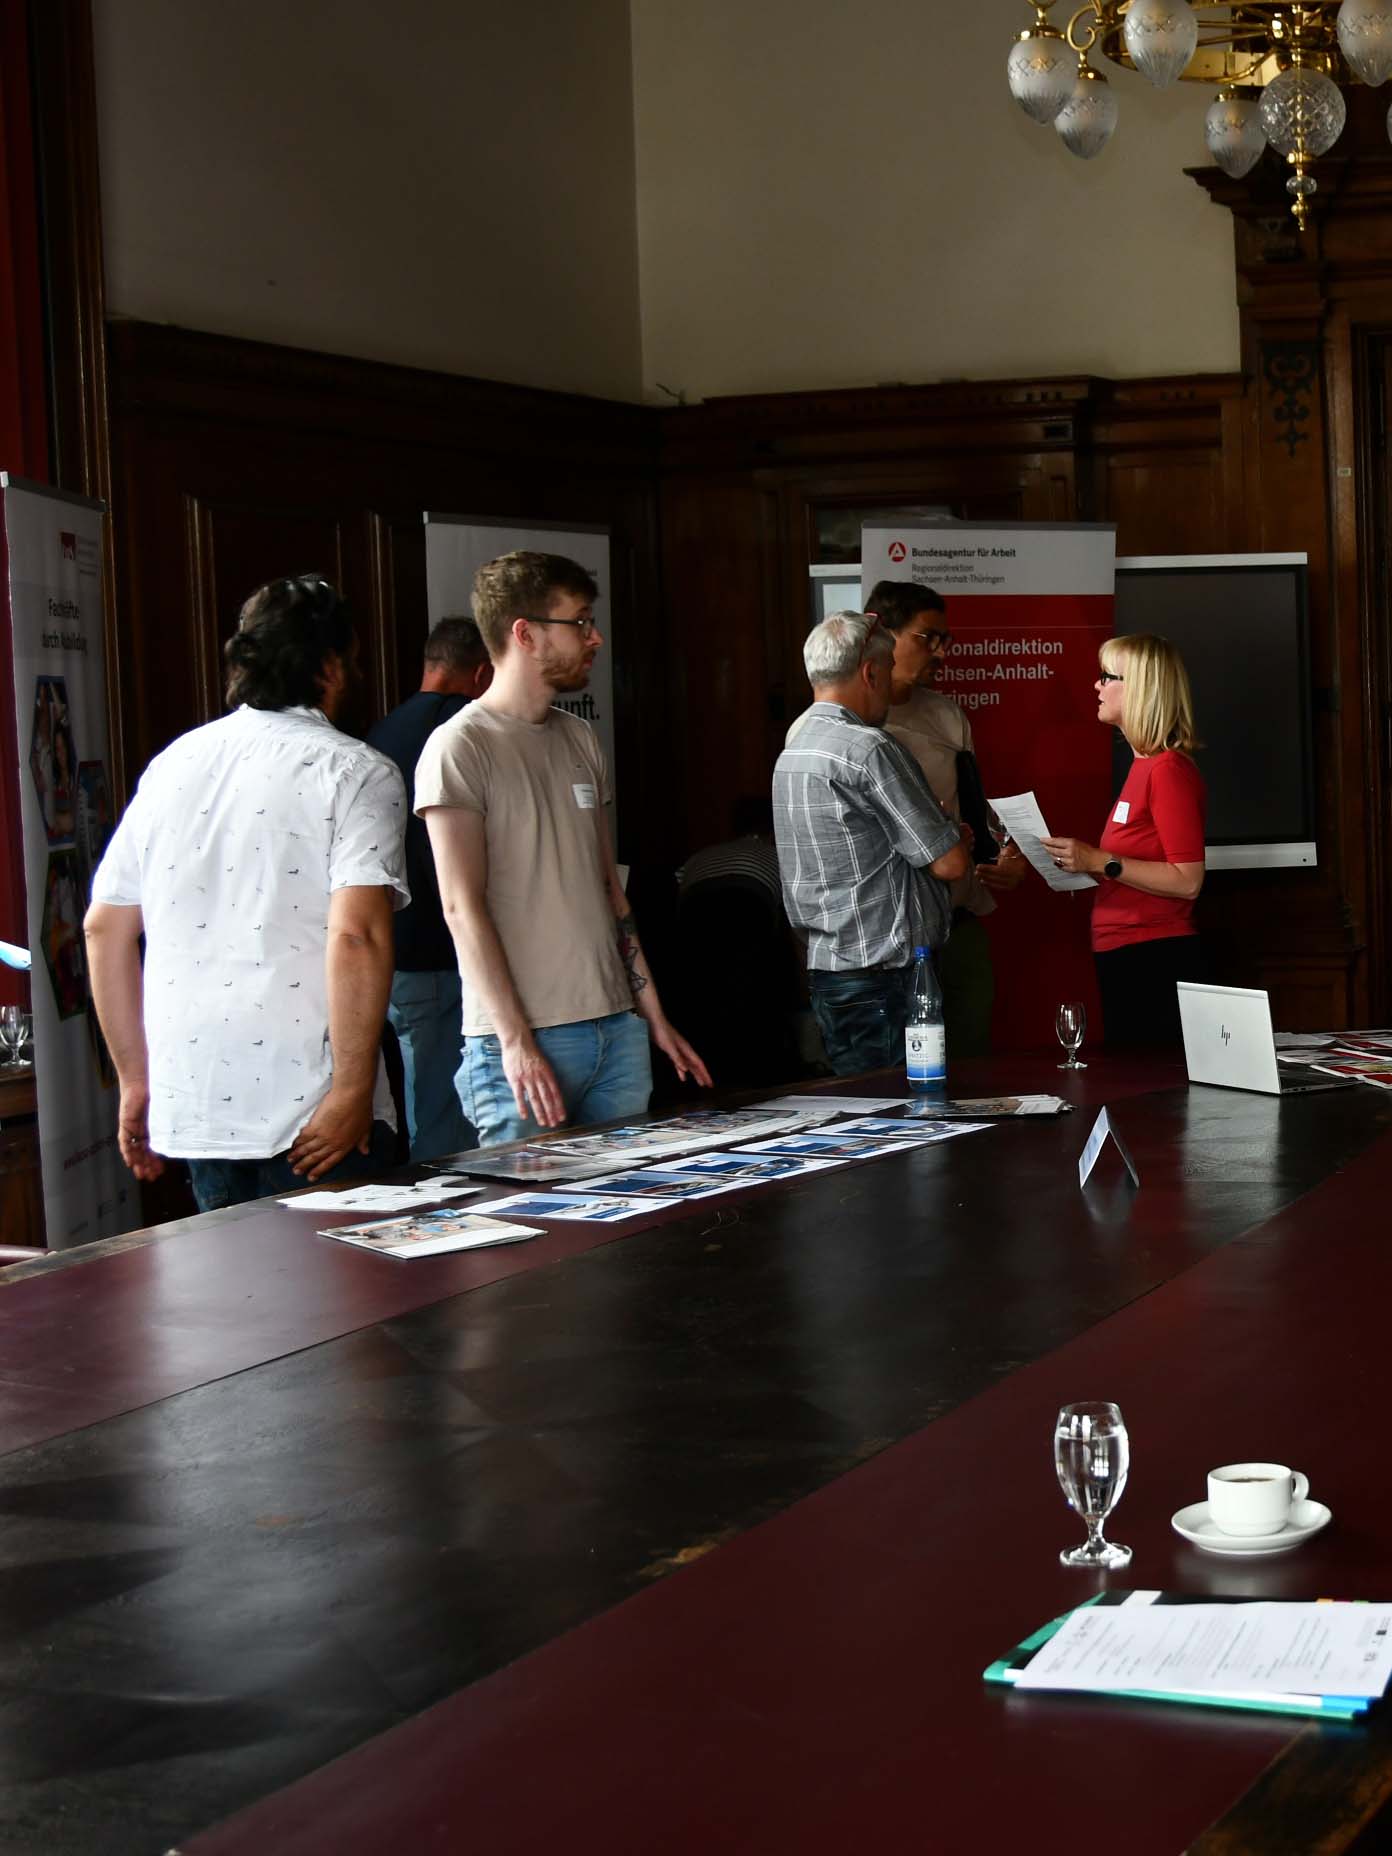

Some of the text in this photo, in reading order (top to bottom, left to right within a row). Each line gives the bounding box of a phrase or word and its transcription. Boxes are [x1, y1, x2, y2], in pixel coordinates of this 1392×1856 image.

[912, 547, 1016, 559] Bundesagentur für Arbeit
